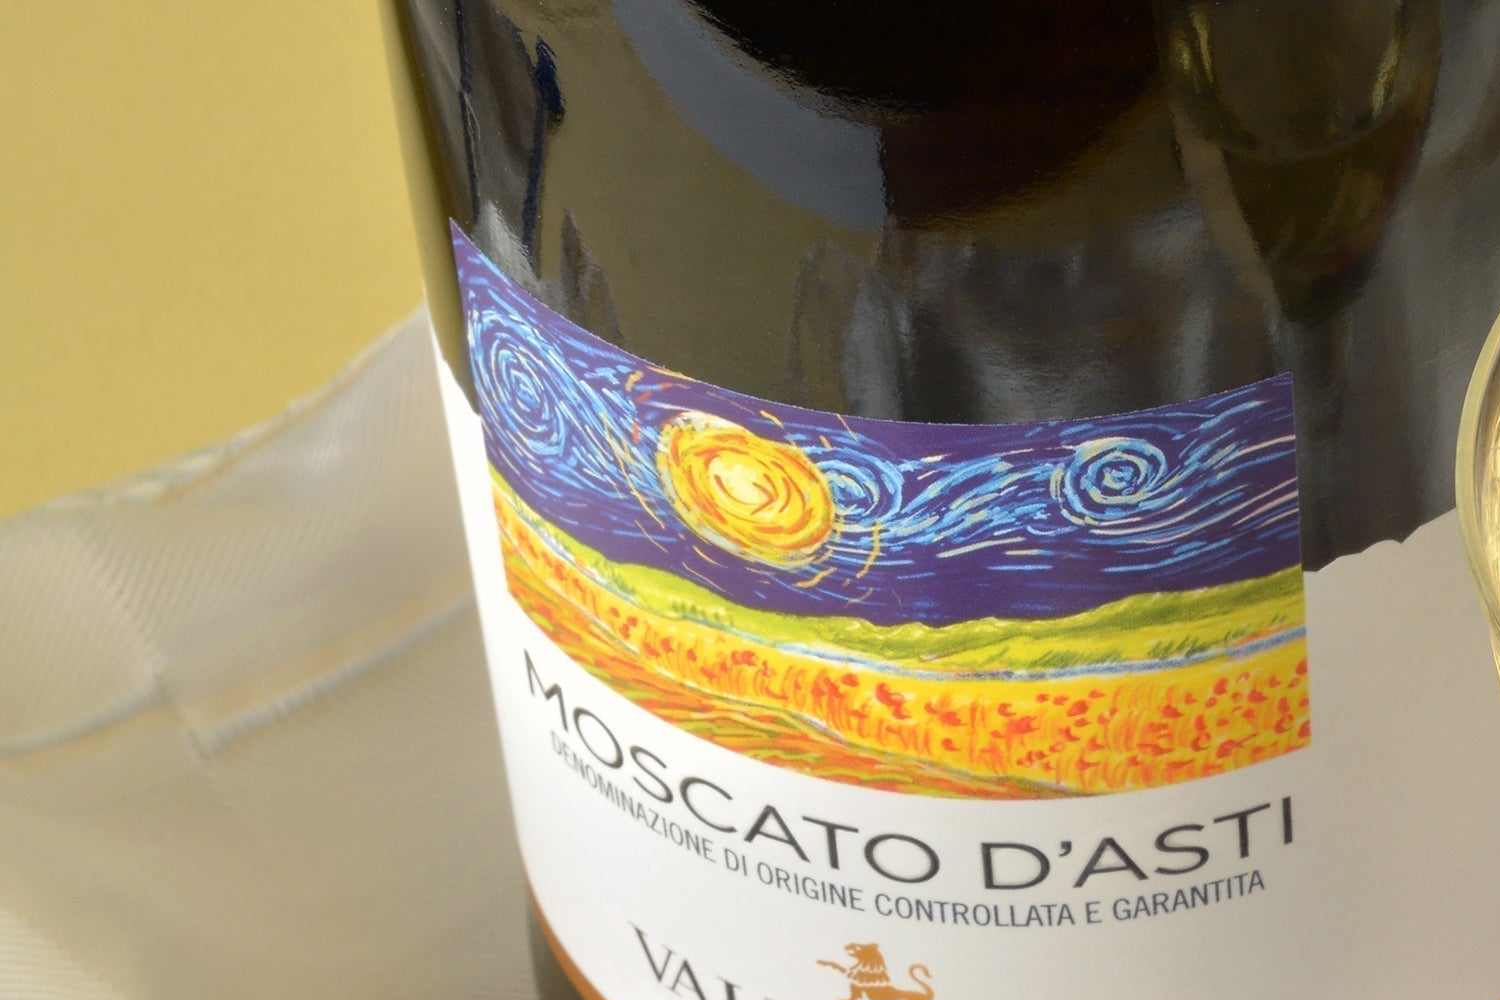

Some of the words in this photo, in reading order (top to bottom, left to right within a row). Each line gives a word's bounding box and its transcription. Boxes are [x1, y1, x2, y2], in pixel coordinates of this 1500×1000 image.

[524, 649, 940, 883] MOSCATO
[981, 796, 1293, 890] D'ASTI
[550, 730, 717, 863] DENOMINAZIONE
[724, 849, 748, 876] DI
[757, 862, 866, 912] ORIGINE
[875, 894, 1075, 927] CONTROLLATA
[1086, 901, 1102, 924] E
[1113, 869, 1266, 921] GARANTITA
